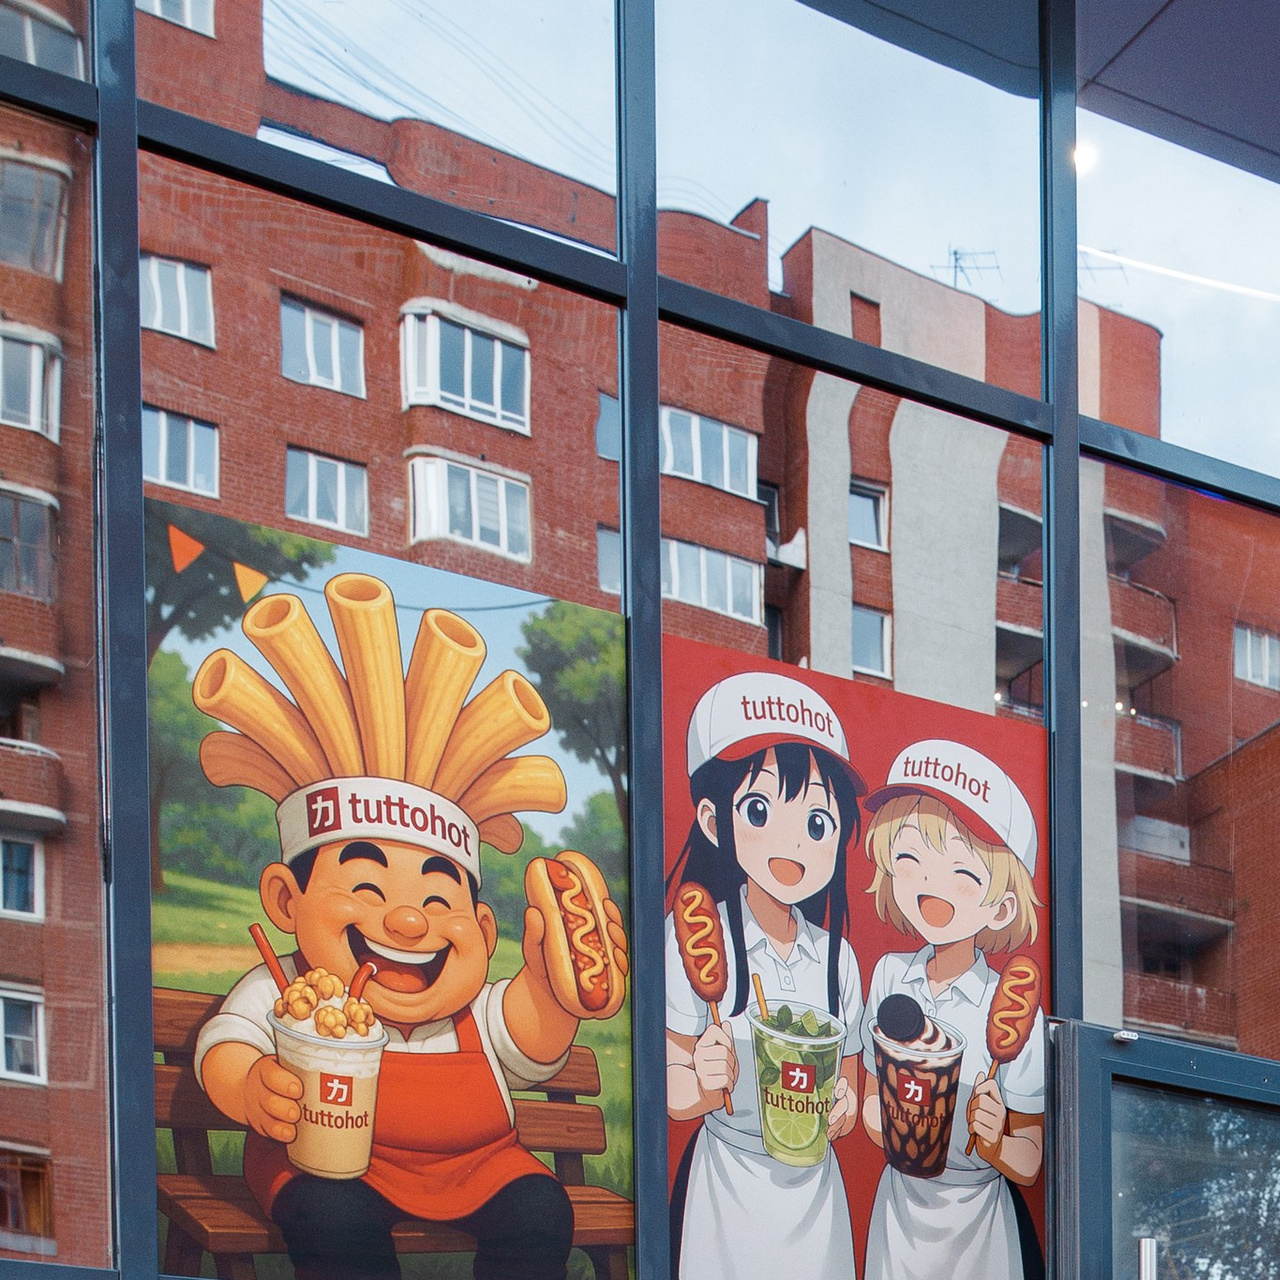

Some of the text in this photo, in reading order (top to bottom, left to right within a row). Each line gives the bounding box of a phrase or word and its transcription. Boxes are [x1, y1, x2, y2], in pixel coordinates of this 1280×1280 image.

[740, 693, 837, 739] tuttohot
[902, 755, 992, 804] tuttohot
[348, 792, 472, 858] tuttohot
[302, 1104, 369, 1129] tuttohot
[763, 1086, 831, 1115] tuttohot
